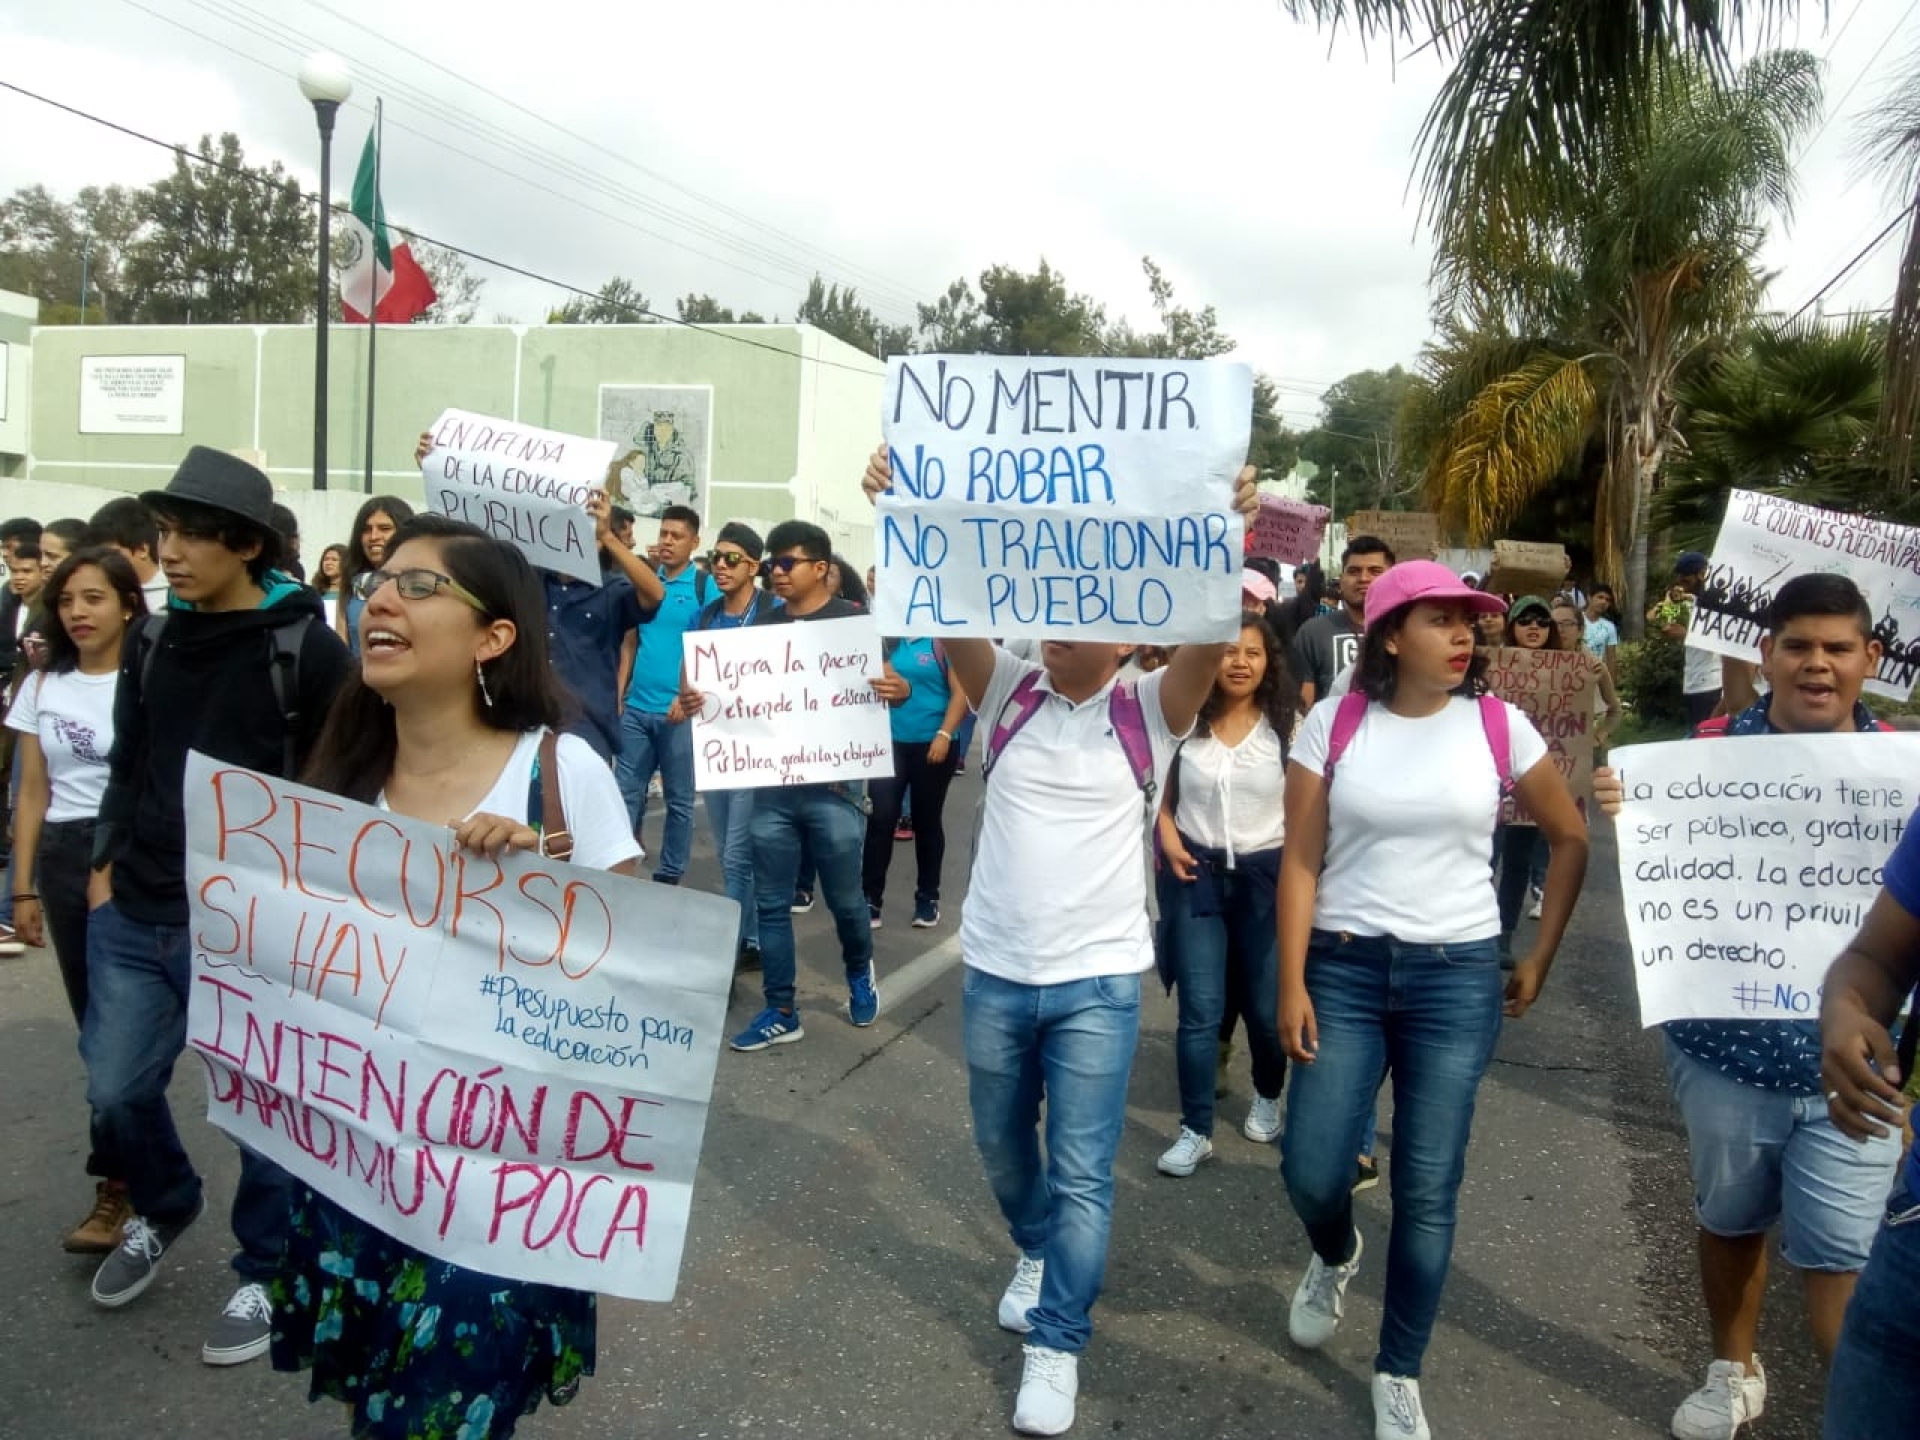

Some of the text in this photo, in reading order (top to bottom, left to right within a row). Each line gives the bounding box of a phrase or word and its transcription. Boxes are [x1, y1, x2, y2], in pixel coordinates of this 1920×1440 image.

[893, 360, 974, 431] NO
[435, 417, 475, 450] EN
[443, 455, 592, 506] DE LA EDUCACIÓ
[884, 443, 1117, 505] NO ROBAR,
[884, 513, 1232, 573] NO TRAICIONAR
[1742, 503, 1760, 526] DE
[1766, 508, 1838, 548] QUIENES
[1836, 527, 1901, 567] PUEDAN
[906, 574, 1173, 626] AL PUEBLO
[695, 642, 772, 690] Mejora
[784, 640, 804, 673] la
[804, 687, 818, 711] la
[1620, 768, 1905, 808] La educación tiene
[1637, 822, 1673, 844] ser
[1805, 814, 1905, 847] gratuit
[211, 769, 611, 980] RECURSO
[1756, 857, 1788, 886] La
[1639, 898, 1861, 931] no es un privil
[198, 874, 408, 1030] SI HAY
[1641, 944, 1673, 967] un
[480, 974, 694, 1051] #Presupuesto para
[495, 1007, 649, 1070] la educación
[191, 974, 666, 1173] INTENCIÓN DE
[347, 1127, 462, 1242] MUY
[488, 1161, 649, 1264] POCA
